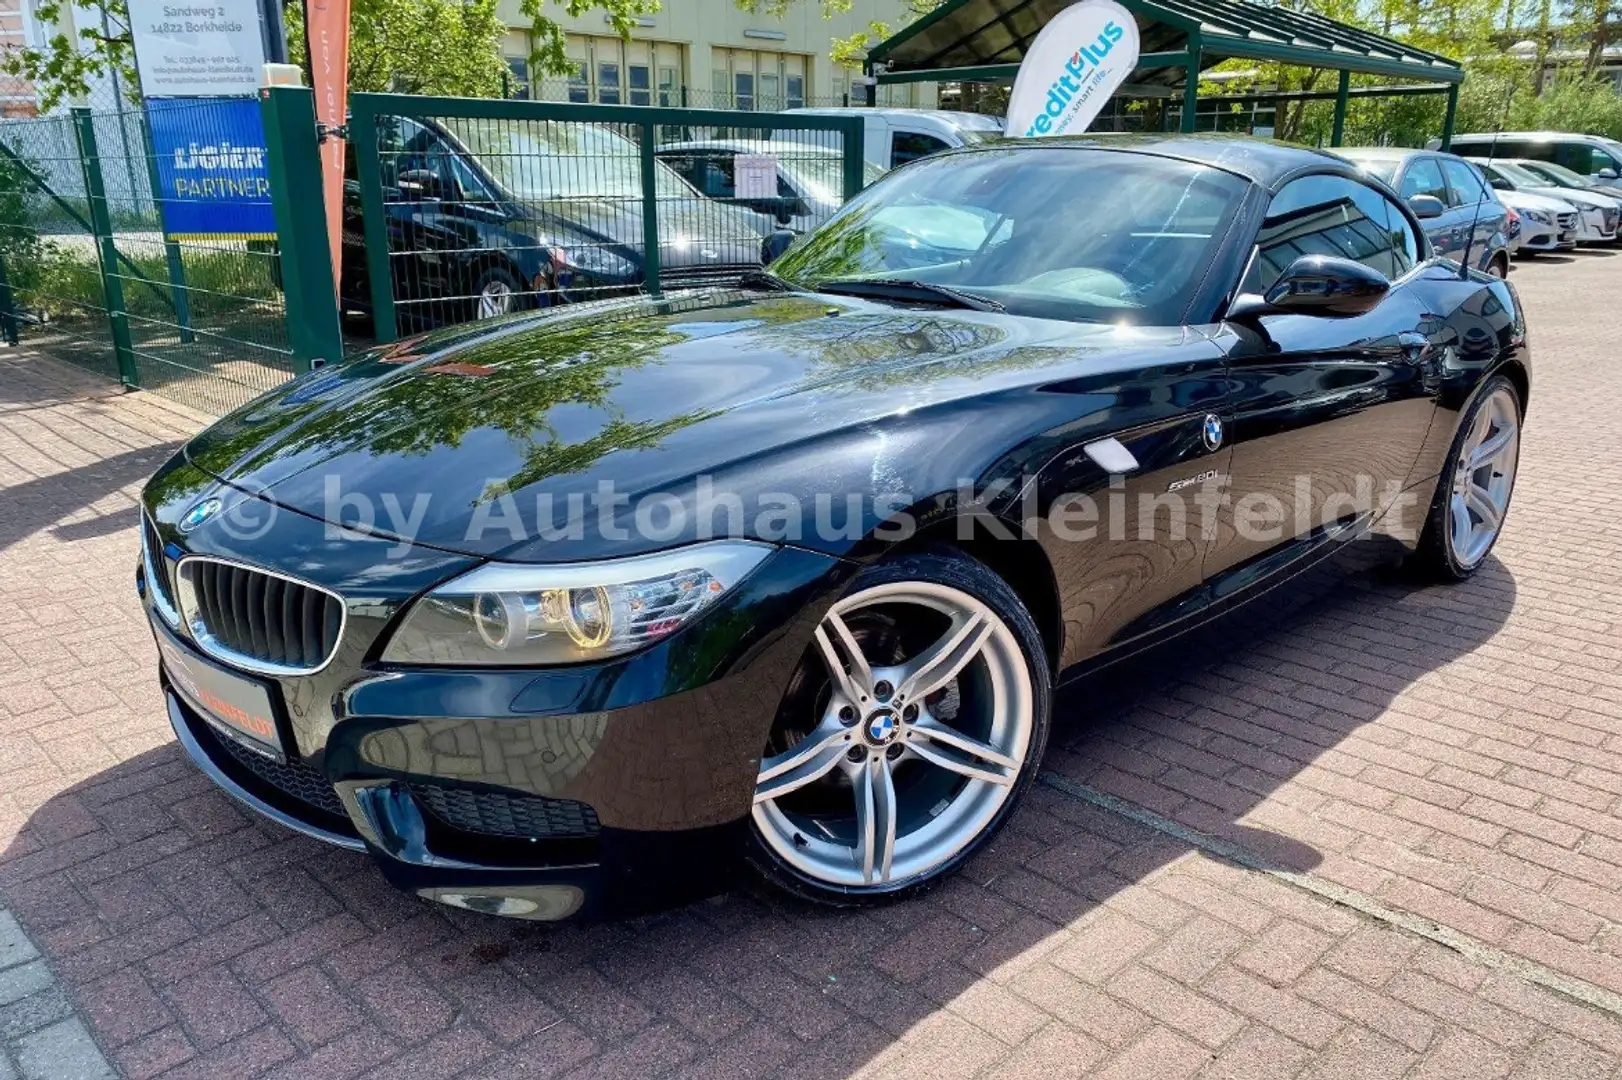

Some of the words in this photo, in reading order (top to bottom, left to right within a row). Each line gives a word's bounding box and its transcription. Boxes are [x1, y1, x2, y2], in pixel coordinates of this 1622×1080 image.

[163, 6, 215, 19] Sandweg
[218, 7, 225, 17] 2
[151, 23, 182, 34] 14822
[185, 22, 243, 33] Borkheide
[320, 30, 331, 73] von
[1025, 20, 1124, 137] reditPlus
[1072, 84, 1095, 114] smart
[175, 177, 272, 198] PARTNER
